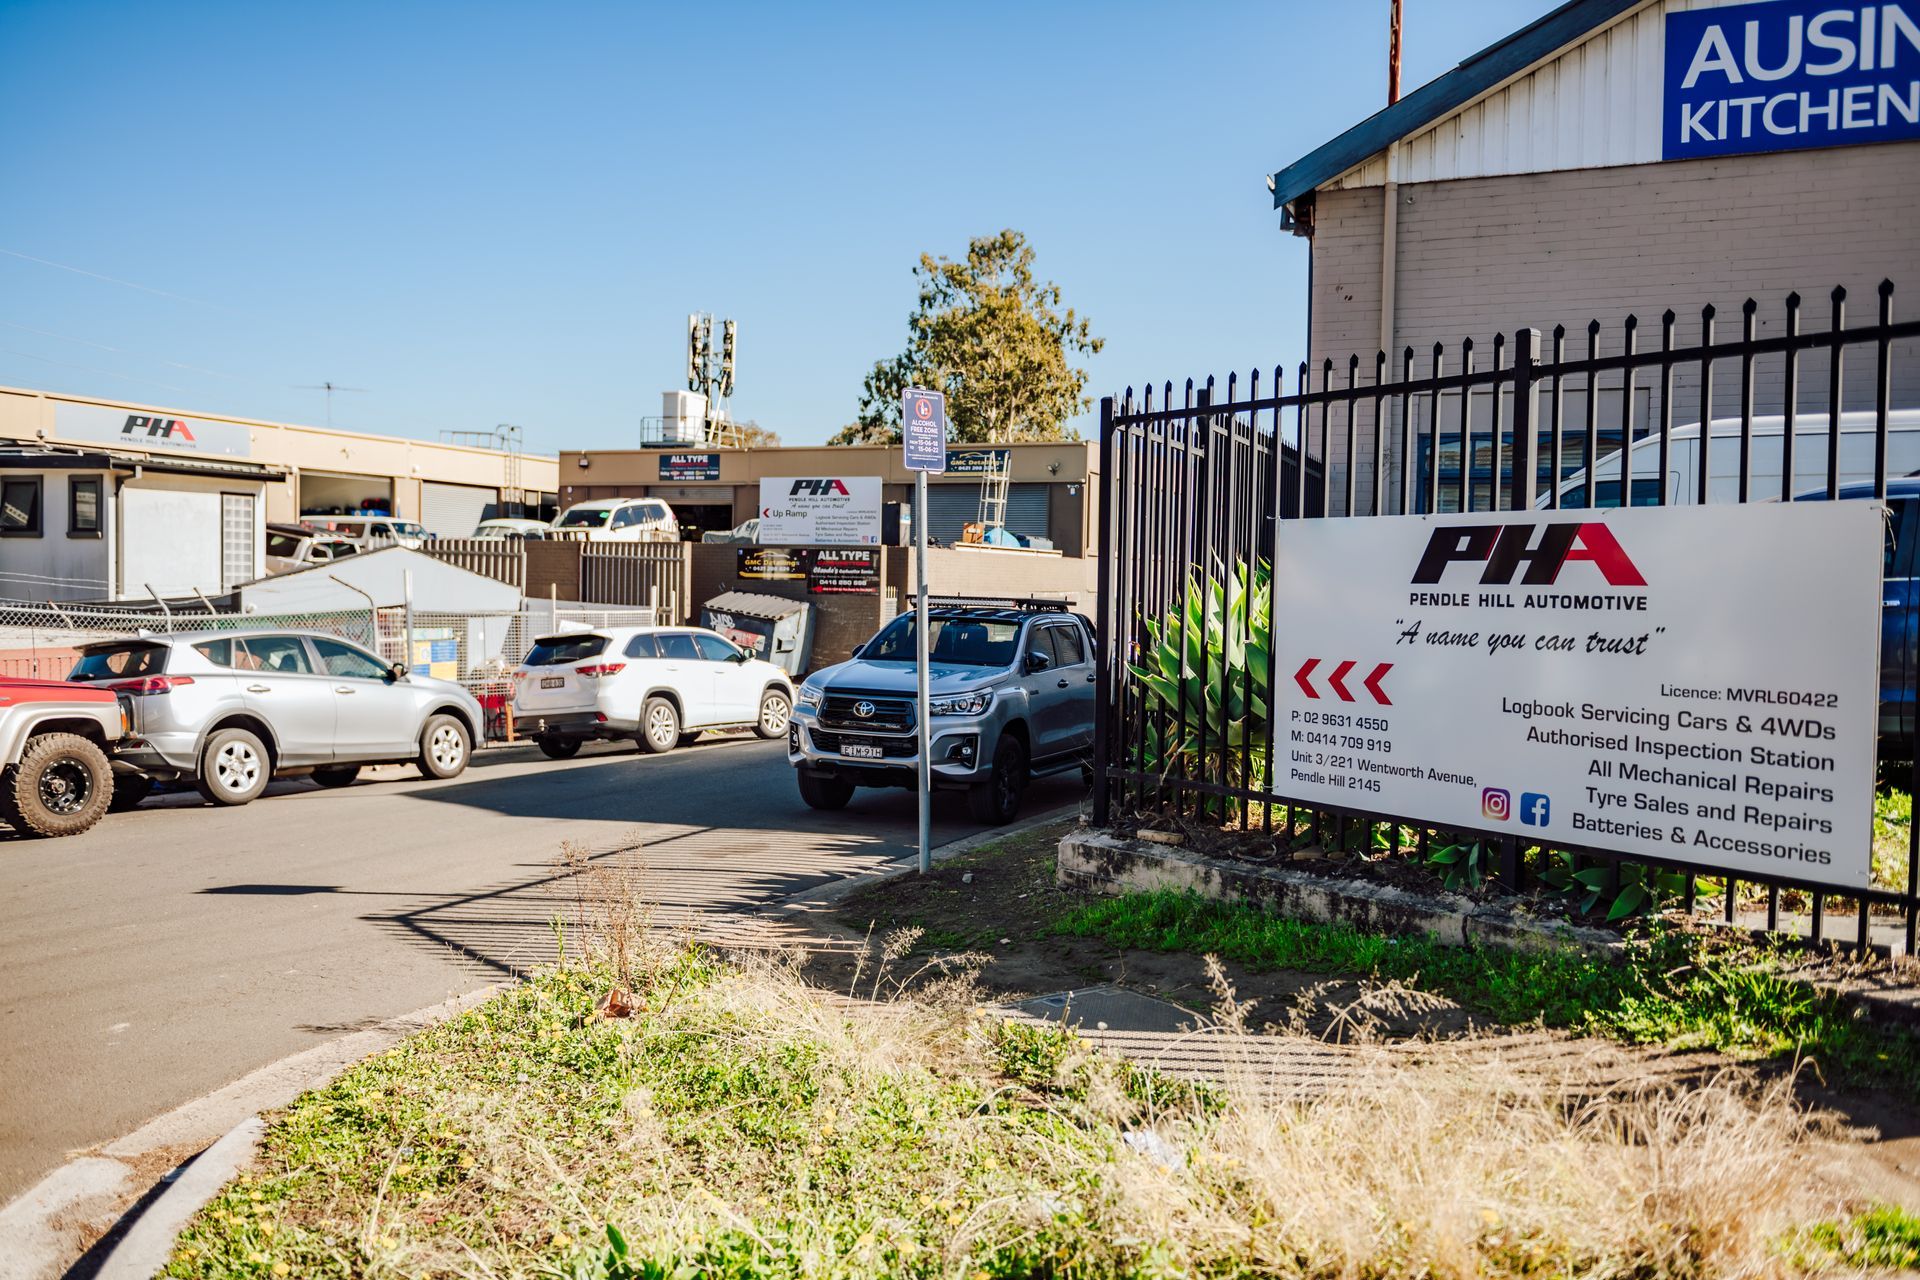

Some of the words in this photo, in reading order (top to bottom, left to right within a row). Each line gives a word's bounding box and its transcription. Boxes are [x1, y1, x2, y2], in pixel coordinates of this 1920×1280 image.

[1681, 80, 1920, 144] KITCHEN
[122, 415, 196, 441] PHA
[912, 420, 936, 428] ALCOHOL
[789, 480, 849, 495] PHA
[786, 510, 807, 518] Ramp
[818, 551, 839, 560] ALL
[840, 551, 870, 560] TYPE
[1410, 522, 1648, 586] PHA
[1410, 593, 1470, 606] PENDLE
[1479, 594, 1514, 608] HILL
[1524, 595, 1647, 611] AUTOMOTIVE
[1426, 630, 1478, 647] name
[1488, 633, 1526, 656] you
[1535, 634, 1576, 652] can
[1661, 684, 1721, 700] Licence:
[1726, 688, 1838, 708] MVRL60422
[1291, 710, 1302, 722] P:
[1304, 712, 1318, 724] 02
[1322, 713, 1352, 728] 9631
[1356, 716, 1389, 732] 4550
[1502, 697, 1575, 719] Logbook
[1581, 703, 1669, 731] Servicing
[1677, 710, 1727, 731] Cars
[1736, 715, 1753, 733] &
[1760, 718, 1836, 740] 4WDs
[1291, 730, 1304, 742] M:
[1306, 732, 1336, 746] 0414
[1340, 735, 1364, 750] 709
[1367, 739, 1392, 753] 919
[1527, 726, 1628, 752] Authorised
[1635, 736, 1741, 762] Inspection
[1750, 746, 1835, 771] Station
[1291, 750, 1312, 764] Unit
[1315, 753, 1352, 770] 3/221
[1358, 759, 1424, 779] Wentworth
[1428, 768, 1477, 788] Avenue,
[1291, 768, 1325, 785] Pendle
[1328, 774, 1345, 788] Hill
[1348, 776, 1381, 793] 2145
[1588, 759, 1611, 777] All
[1619, 763, 1736, 792] Mechanical
[1745, 776, 1834, 803] Repairs
[1586, 786, 1627, 808] Tyre
[1634, 793, 1689, 816] Sales
[1696, 804, 1735, 822] and
[1744, 806, 1832, 834] Repairs
[1572, 812, 1663, 841] Batteries
[1670, 826, 1686, 844] &
[1694, 829, 1832, 866] Accessories
